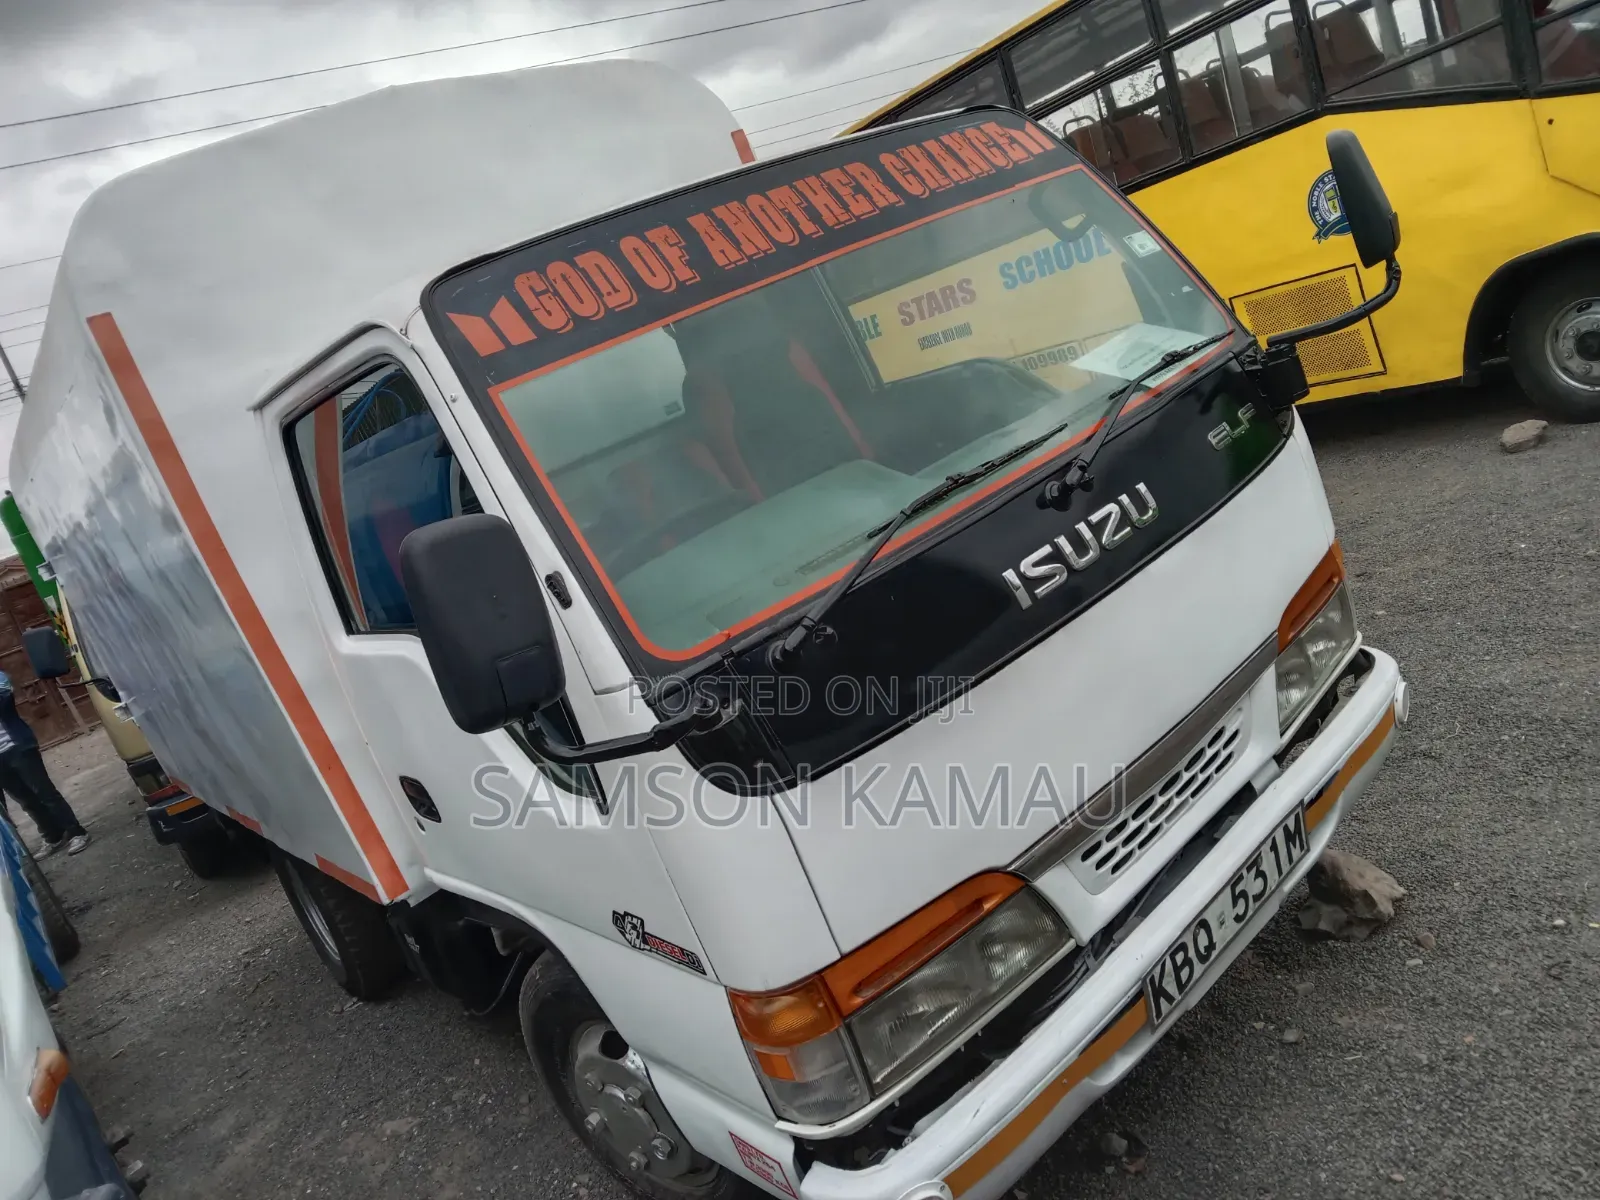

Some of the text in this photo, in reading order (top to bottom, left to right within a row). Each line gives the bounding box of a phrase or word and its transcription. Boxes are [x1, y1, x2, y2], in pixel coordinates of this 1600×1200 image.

[514, 121, 1034, 334] GOD OF ANOTHER CHANCE
[855, 313, 883, 341] BLE
[897, 277, 977, 327] STARS
[1207, 402, 1257, 451] ELF
[1002, 482, 1159, 611] ISUZU
[646, 935, 688, 961] DIESEL
[1147, 811, 1306, 1022] KBQ 531M
